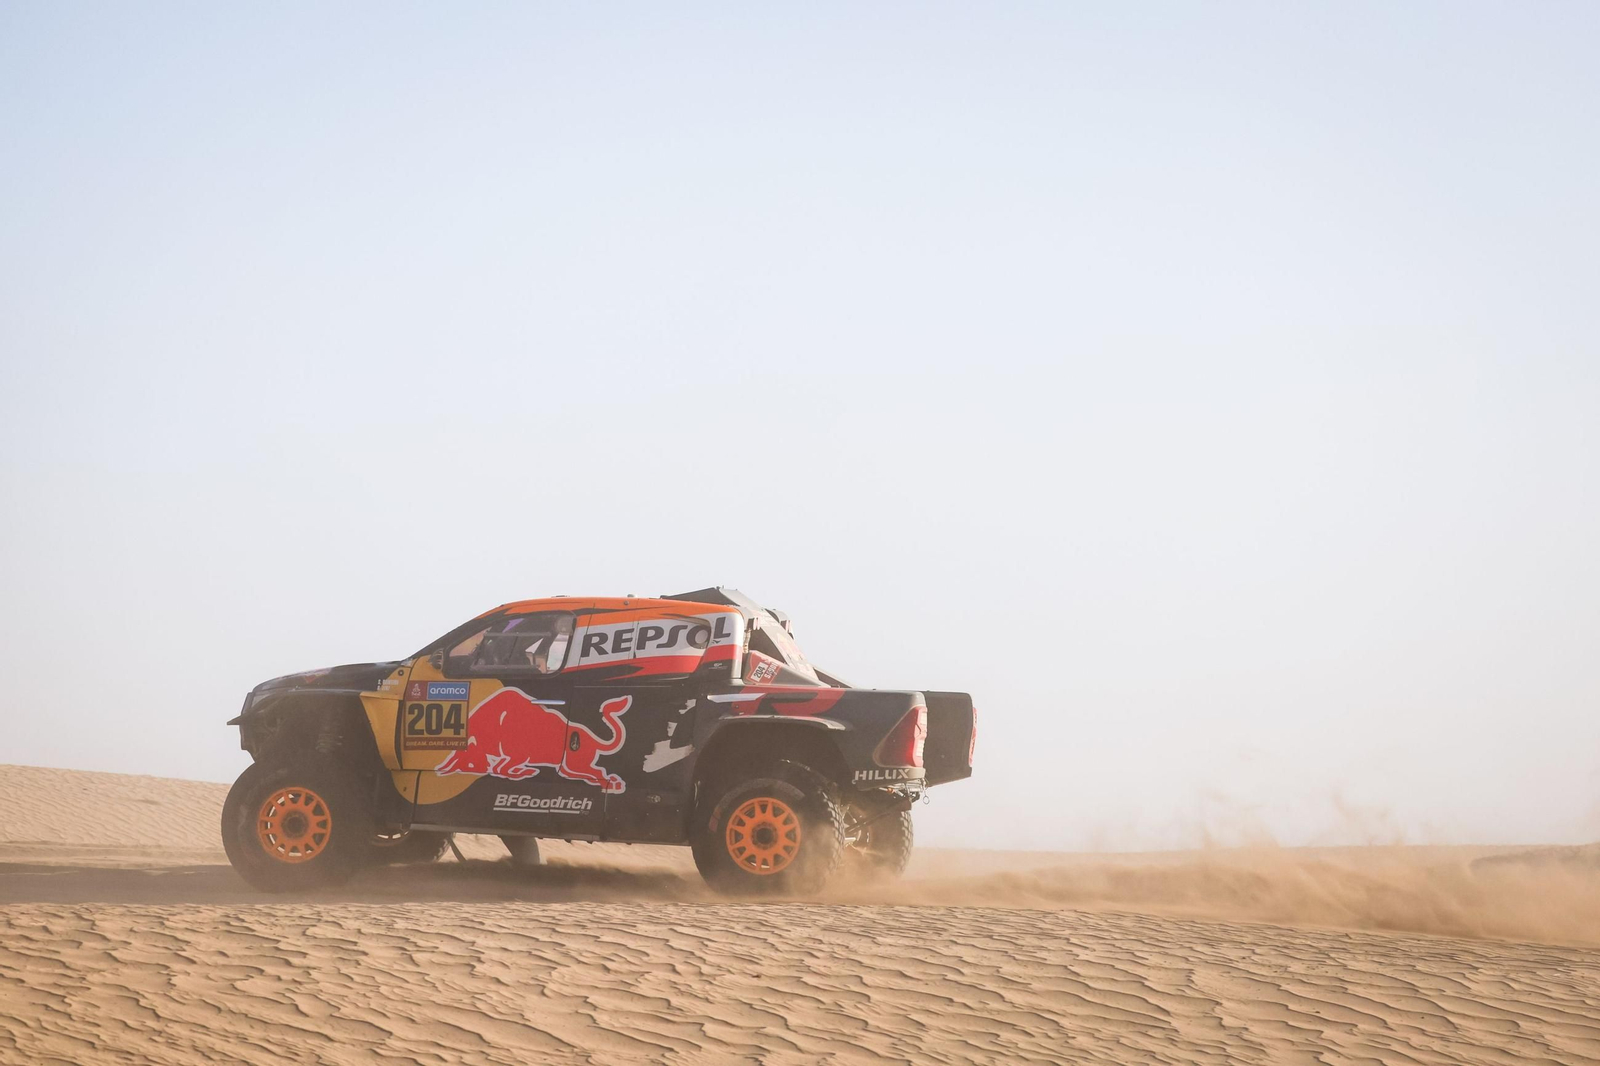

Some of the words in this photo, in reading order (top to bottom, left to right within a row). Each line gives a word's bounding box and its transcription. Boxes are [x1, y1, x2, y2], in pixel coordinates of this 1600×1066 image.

[580, 616, 731, 658] REPSOL
[754, 666, 765, 678] 204
[430, 687, 466, 695] aramco
[408, 703, 465, 736] 204
[854, 768, 911, 781] HILUX
[494, 793, 593, 810] BFGoodrich
